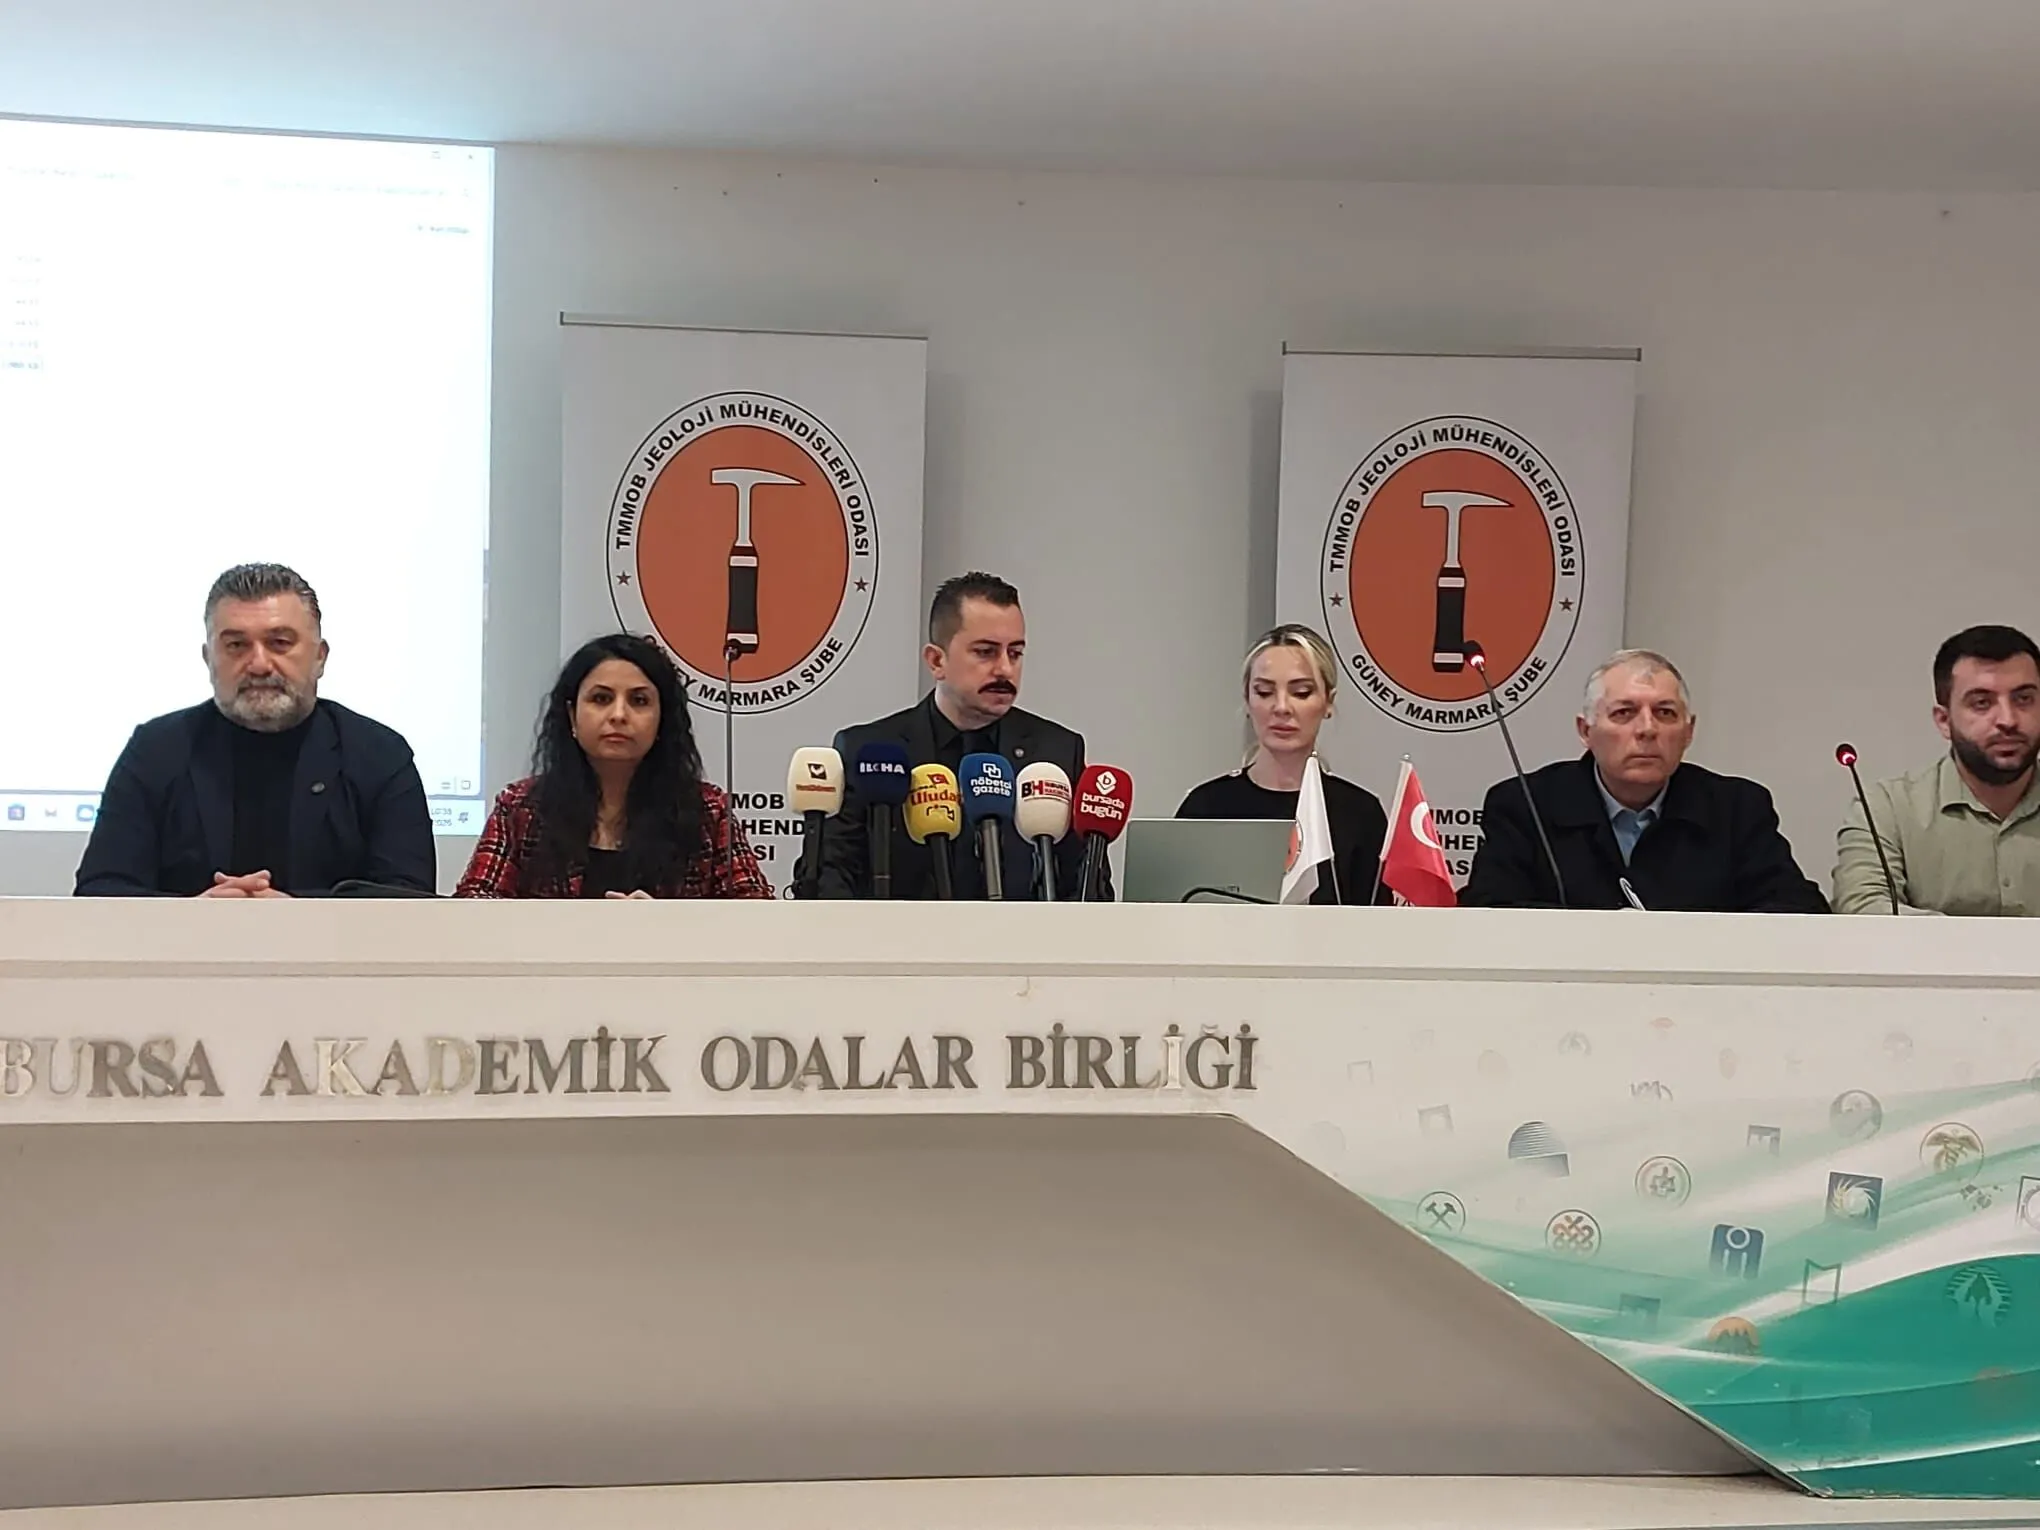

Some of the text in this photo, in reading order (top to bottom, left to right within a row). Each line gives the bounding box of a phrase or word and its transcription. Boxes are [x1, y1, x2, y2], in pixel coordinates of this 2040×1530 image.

[616, 401, 869, 556] TMMOB JEOLOJİ MÜHENDİSLERİ ODASI
[1330, 424, 1575, 576] TMMOB JEOLOJİ MÜHENDİSLERİ ODASI
[698, 637, 843, 706] MARMARA ŞUBE
[1351, 654, 1547, 724] GÜNEY MARMARA ŞUBE
[731, 793, 785, 809] MOB
[972, 786, 1011, 797] gazete
[1080, 802, 1122, 820] bugün
[1082, 792, 1125, 809] bursada
[0, 1022, 1259, 1098] BURSA AKADEMİK ODALAR BİRLİĞİ
